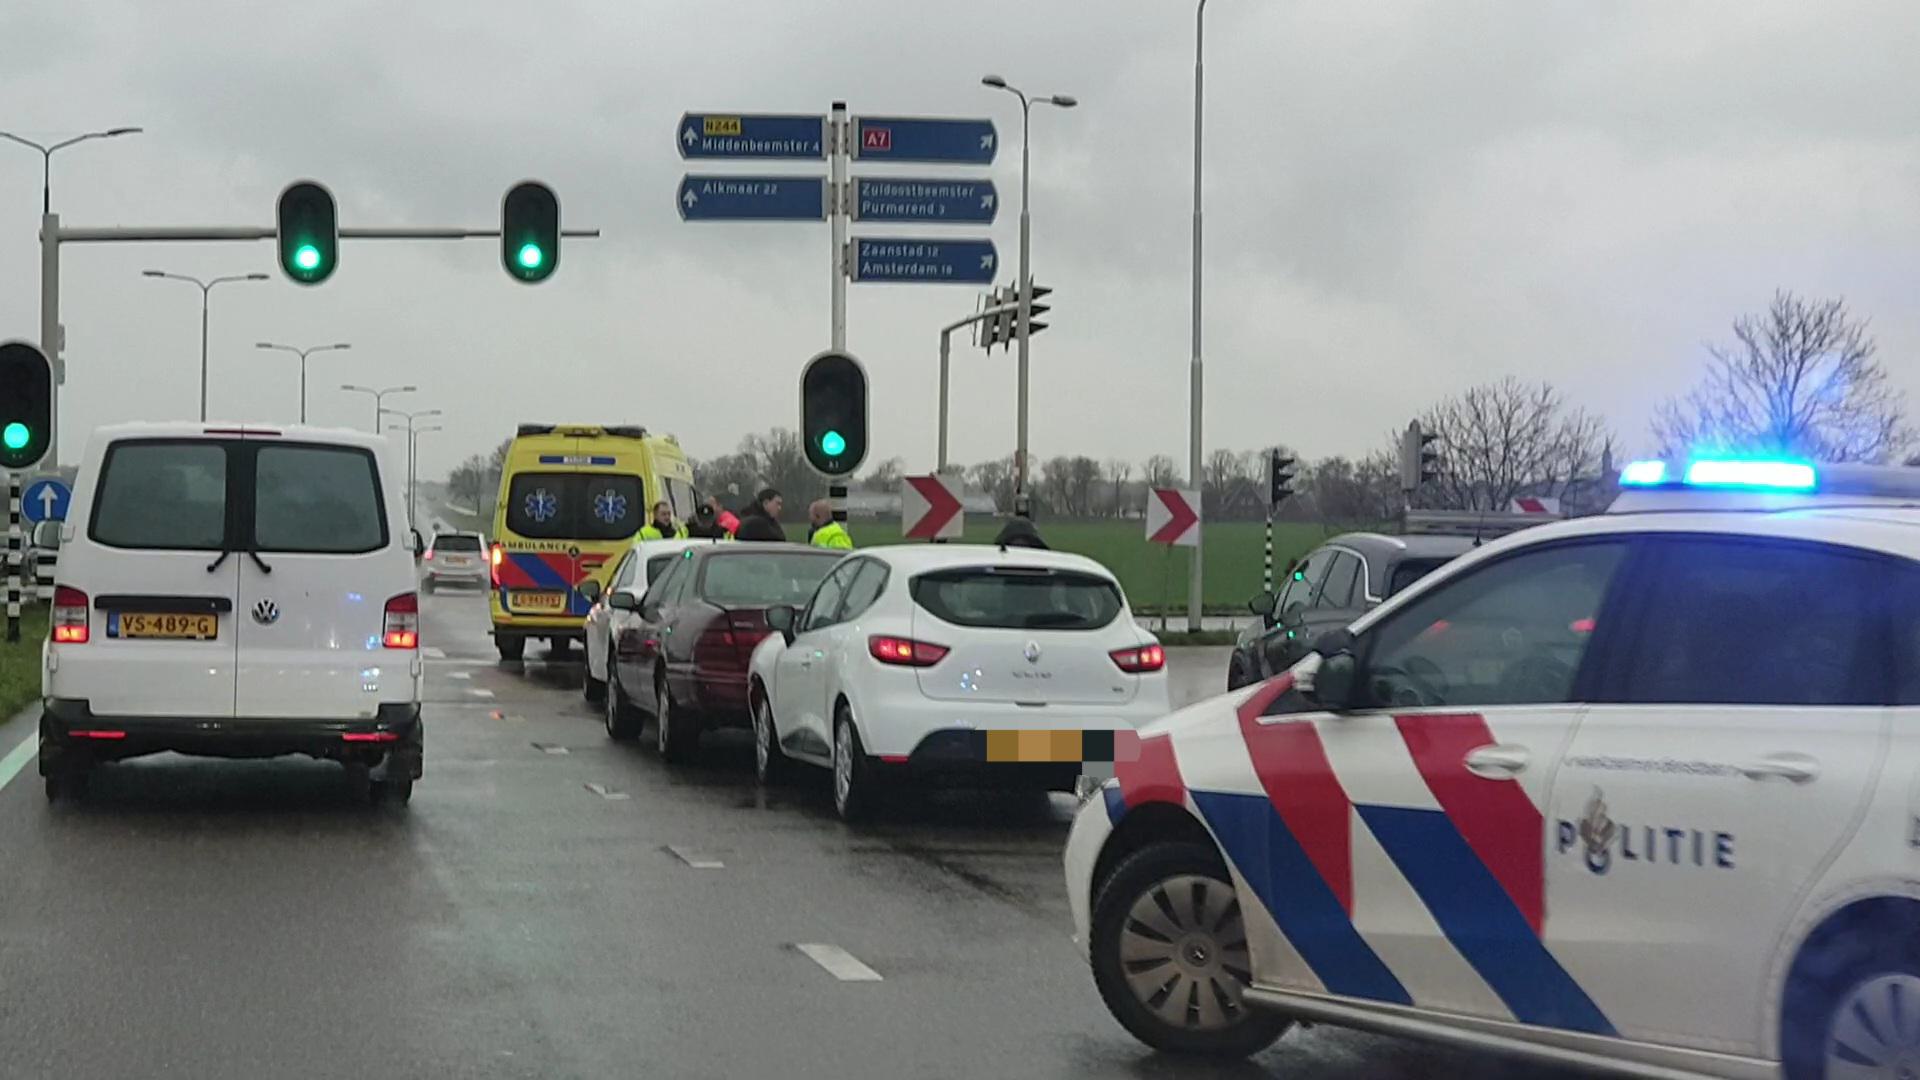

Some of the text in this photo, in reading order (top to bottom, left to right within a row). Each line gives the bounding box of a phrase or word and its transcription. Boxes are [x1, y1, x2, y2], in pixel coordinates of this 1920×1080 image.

[705, 120, 738, 131] N244
[702, 138, 819, 152] Middenbeemster 4
[867, 132, 886, 146] A7
[702, 181, 778, 195] Alkmaar 22
[862, 183, 975, 197] Zuidoostbeemster
[862, 202, 934, 215] Purmerend
[862, 243, 923, 257] Zaanstad
[862, 261, 937, 275] Amsterdam
[501, 541, 567, 550] AMBULANCE
[122, 616, 209, 633] VS-489-G
[1557, 818, 1735, 876] POLITIE
